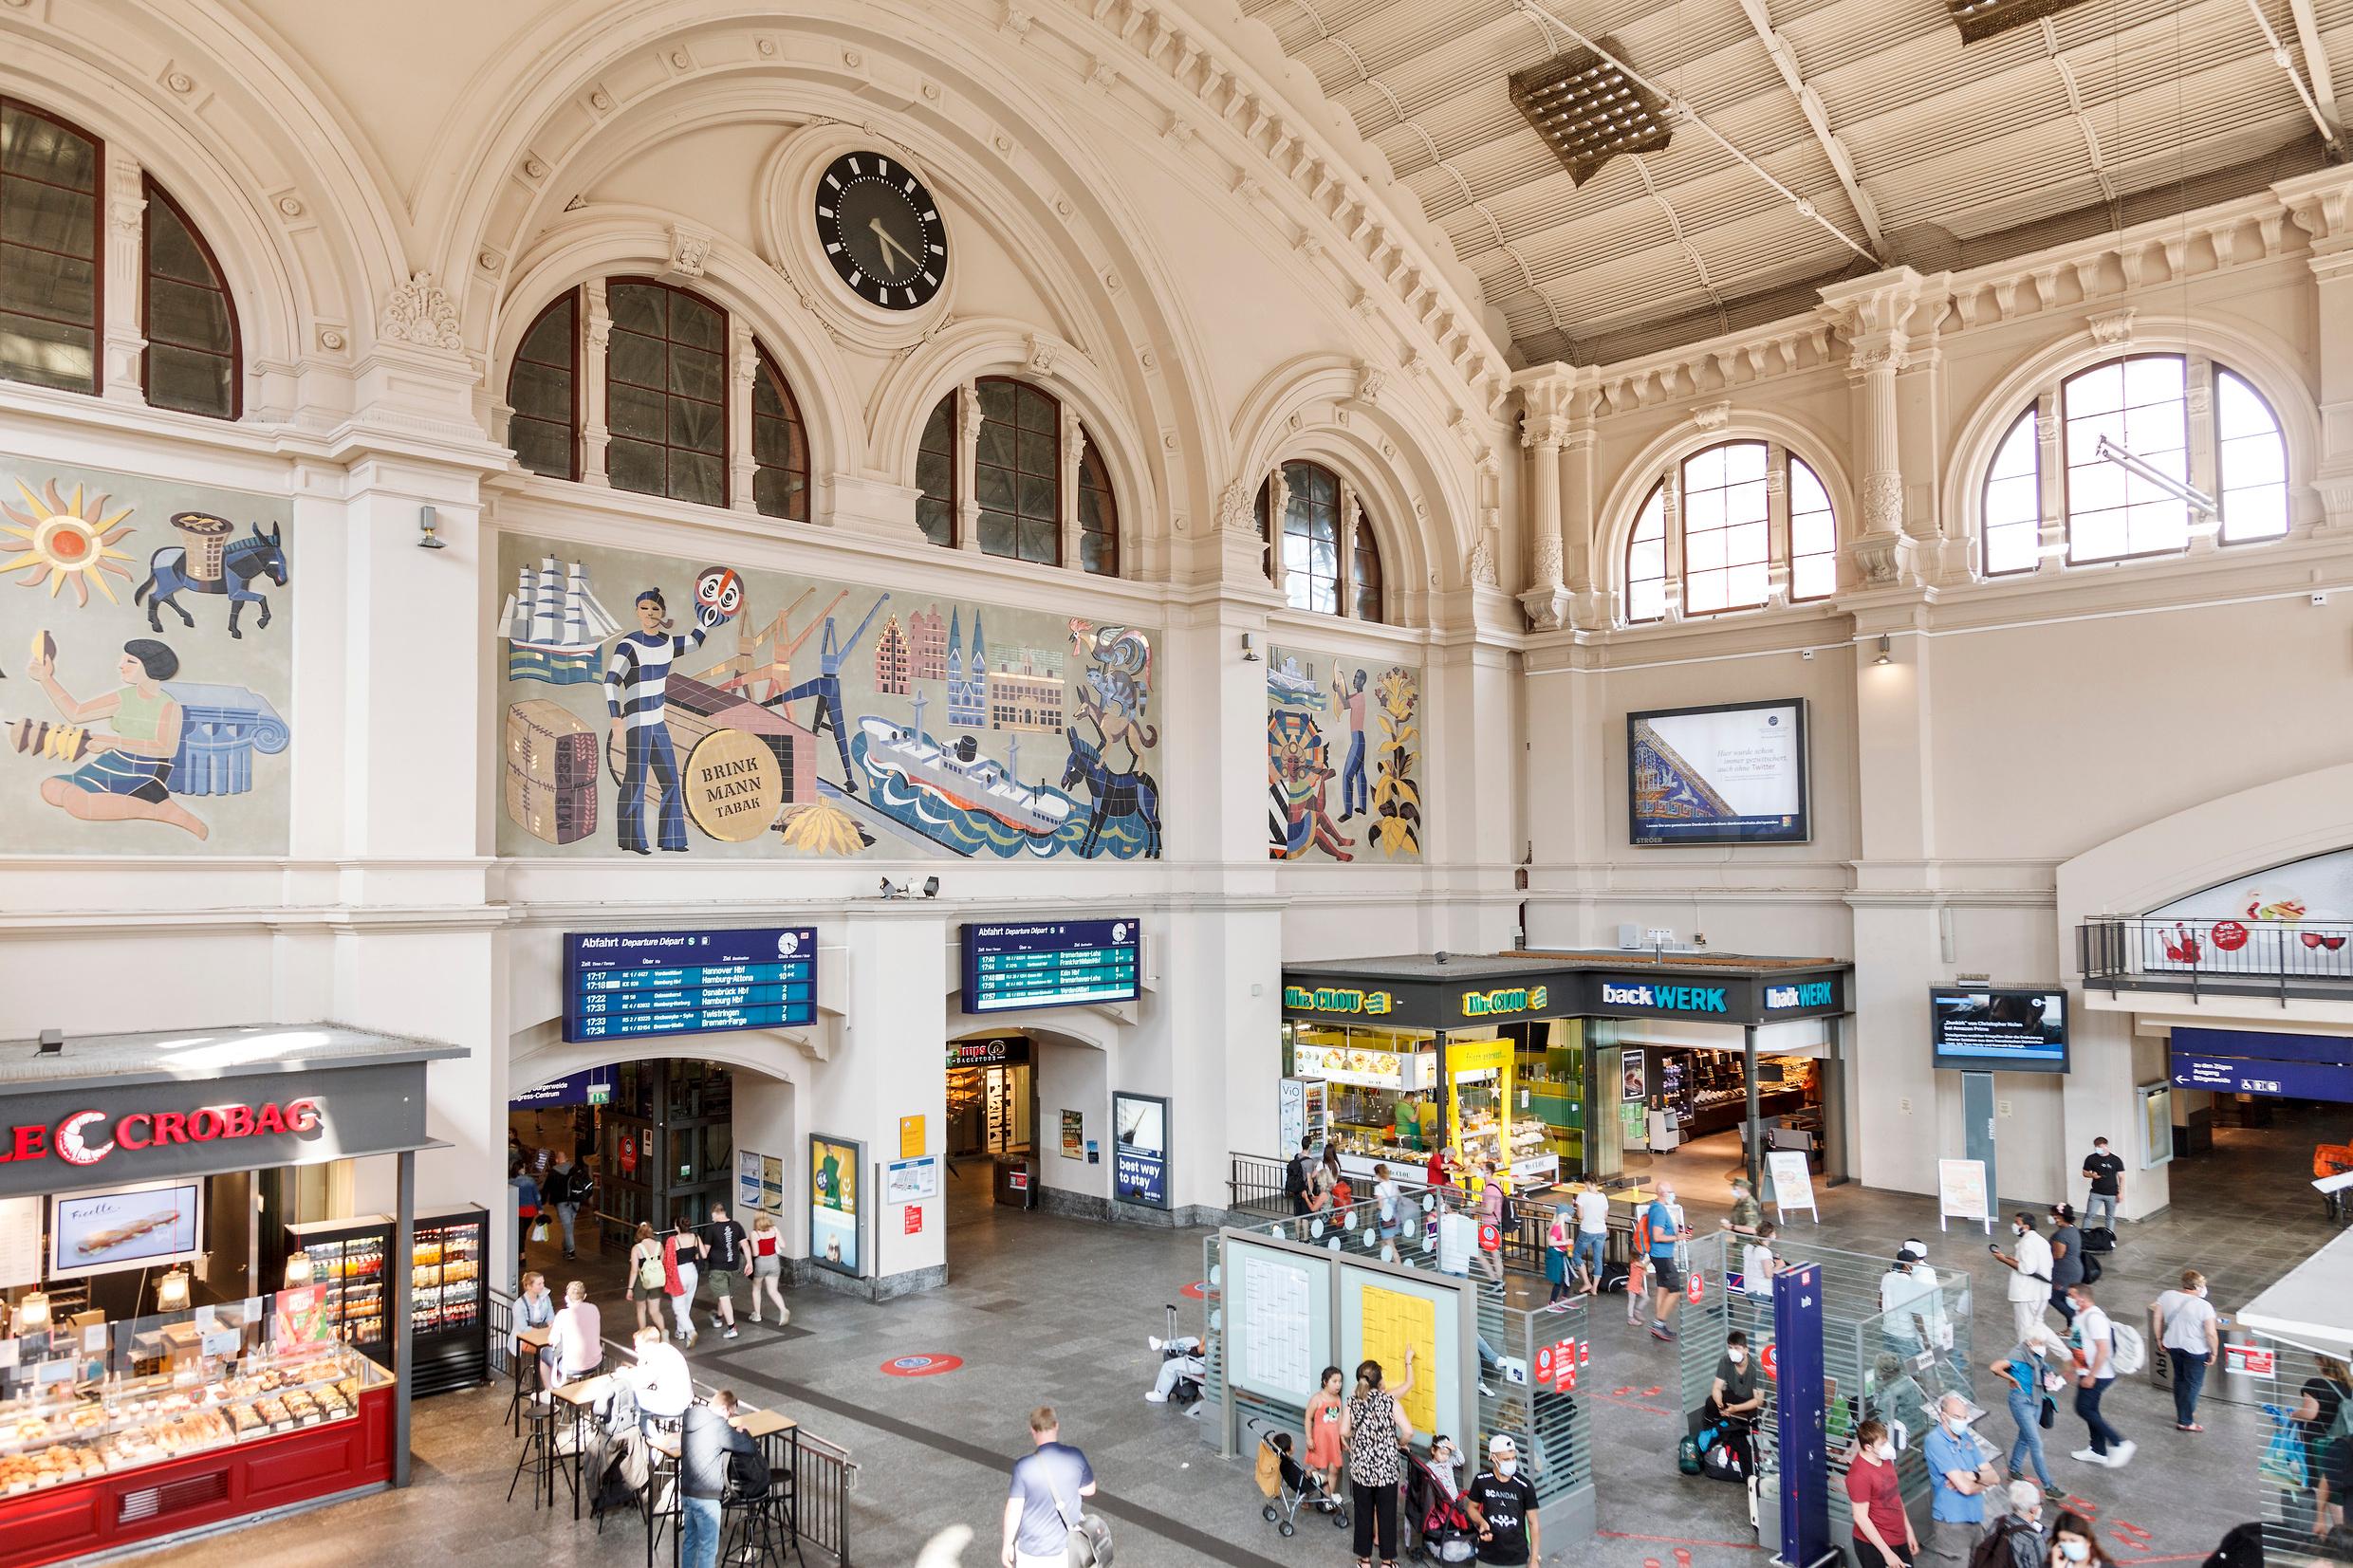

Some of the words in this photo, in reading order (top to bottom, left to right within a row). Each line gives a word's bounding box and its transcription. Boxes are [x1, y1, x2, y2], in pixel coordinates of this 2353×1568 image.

[702, 757, 759, 783] BRINK
[706, 776, 762, 802] MANN
[715, 797, 761, 819] TABAK
[978, 928, 1004, 936] Abfahrt
[1006, 928, 1030, 936] Departure
[582, 937, 620, 949] Abfahrt
[621, 937, 658, 949] Departure
[659, 937, 685, 948] Départ
[586, 971, 607, 981] 17:17
[586, 982, 605, 990] 17:18
[702, 975, 754, 985] Hamburg-Altona
[586, 994, 606, 1004] 17:22
[702, 988, 736, 997] Osnabrück
[738, 987, 750, 995] Hbf
[1285, 989, 1312, 1007] Mr.
[1313, 990, 1361, 1010] CLOU
[1468, 995, 1492, 1014] Mr.
[1491, 991, 1529, 1012] CLOU
[586, 1005, 606, 1013] 17:33
[702, 997, 731, 1005] Hamburg
[586, 1018, 606, 1026] 17:33
[703, 1009, 740, 1019] Twistringen
[586, 1027, 605, 1036] 17:34
[702, 1018, 748, 1027] Bremen-Farge
[0, 1124, 47, 1163] E
[116, 1100, 320, 1152] CROBAG
[1120, 1157, 1139, 1173] best
[1140, 1164, 1160, 1179] way
[1120, 1171, 1130, 1184] to
[1131, 1174, 1151, 1190] stay
[2156, 1351, 2167, 1379] Abf
[1485, 1489, 1519, 1501] SCANDAL
